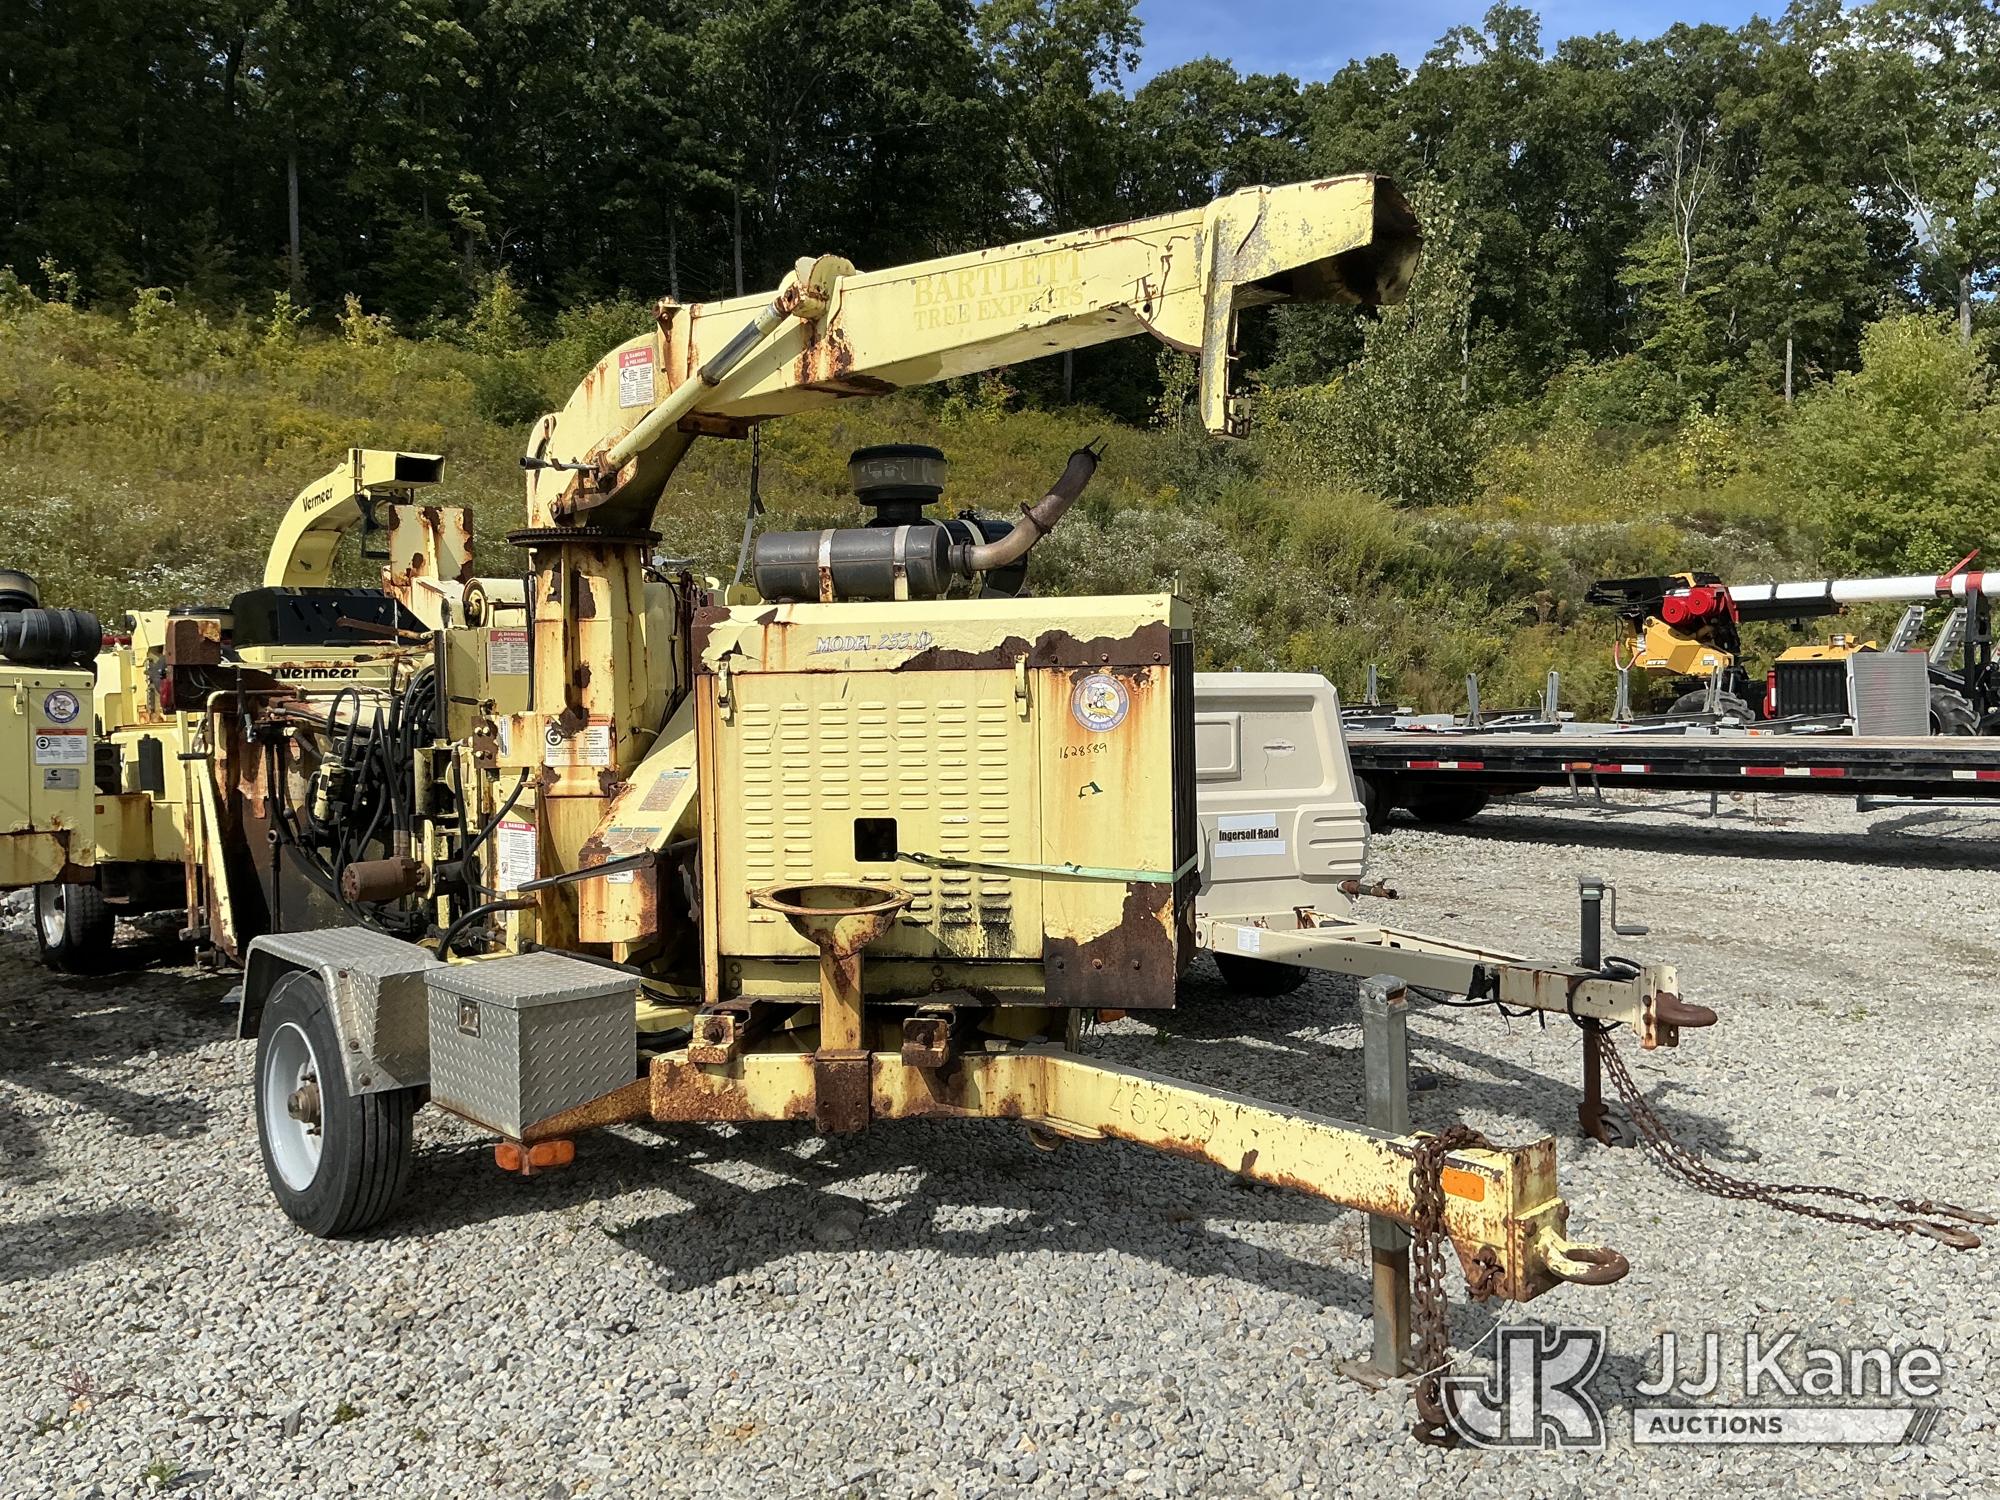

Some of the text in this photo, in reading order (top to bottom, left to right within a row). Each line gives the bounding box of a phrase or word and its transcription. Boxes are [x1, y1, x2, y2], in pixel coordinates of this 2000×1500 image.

[914, 252, 1086, 307] BARTLETT
[914, 303, 971, 332] TREE
[302, 488, 333, 512] Vermeer
[816, 635, 870, 653] MODEL
[280, 668, 360, 679] Vermeer
[1060, 742, 1107, 759] 1628589
